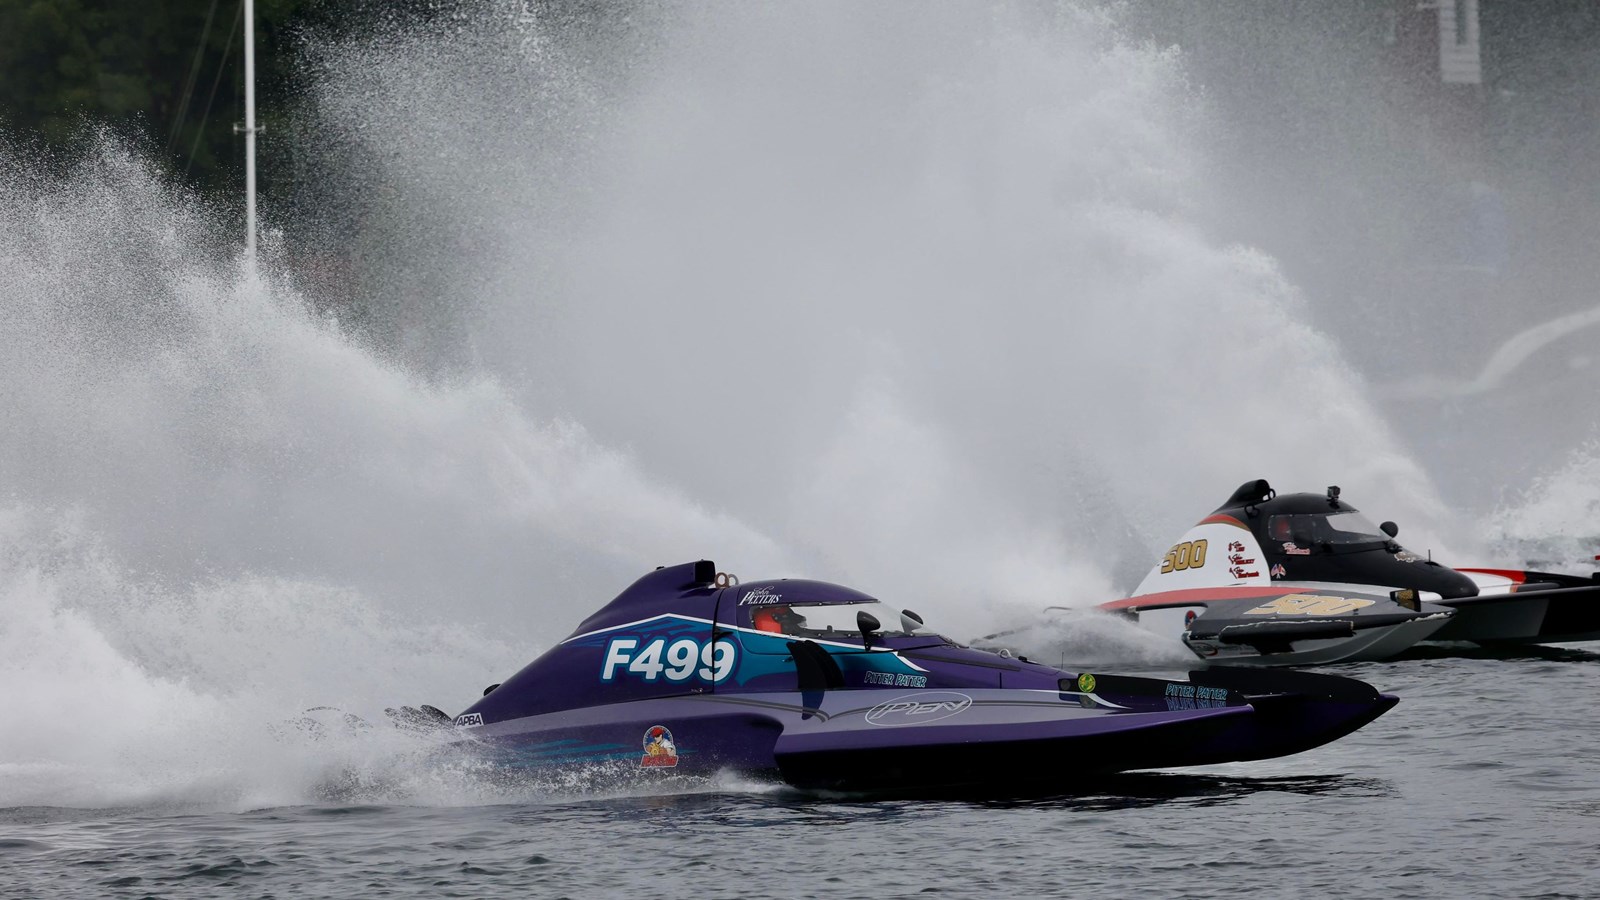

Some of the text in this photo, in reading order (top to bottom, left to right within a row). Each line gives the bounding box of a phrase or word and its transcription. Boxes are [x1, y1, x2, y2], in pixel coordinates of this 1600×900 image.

[1160, 538, 1208, 575] 500
[737, 591, 783, 606] PEETERS
[602, 639, 735, 681] F499
[864, 671, 927, 688] PITTER PATTER
[1165, 683, 1228, 700] PITTER PATTER
[456, 714, 482, 727] APBA
